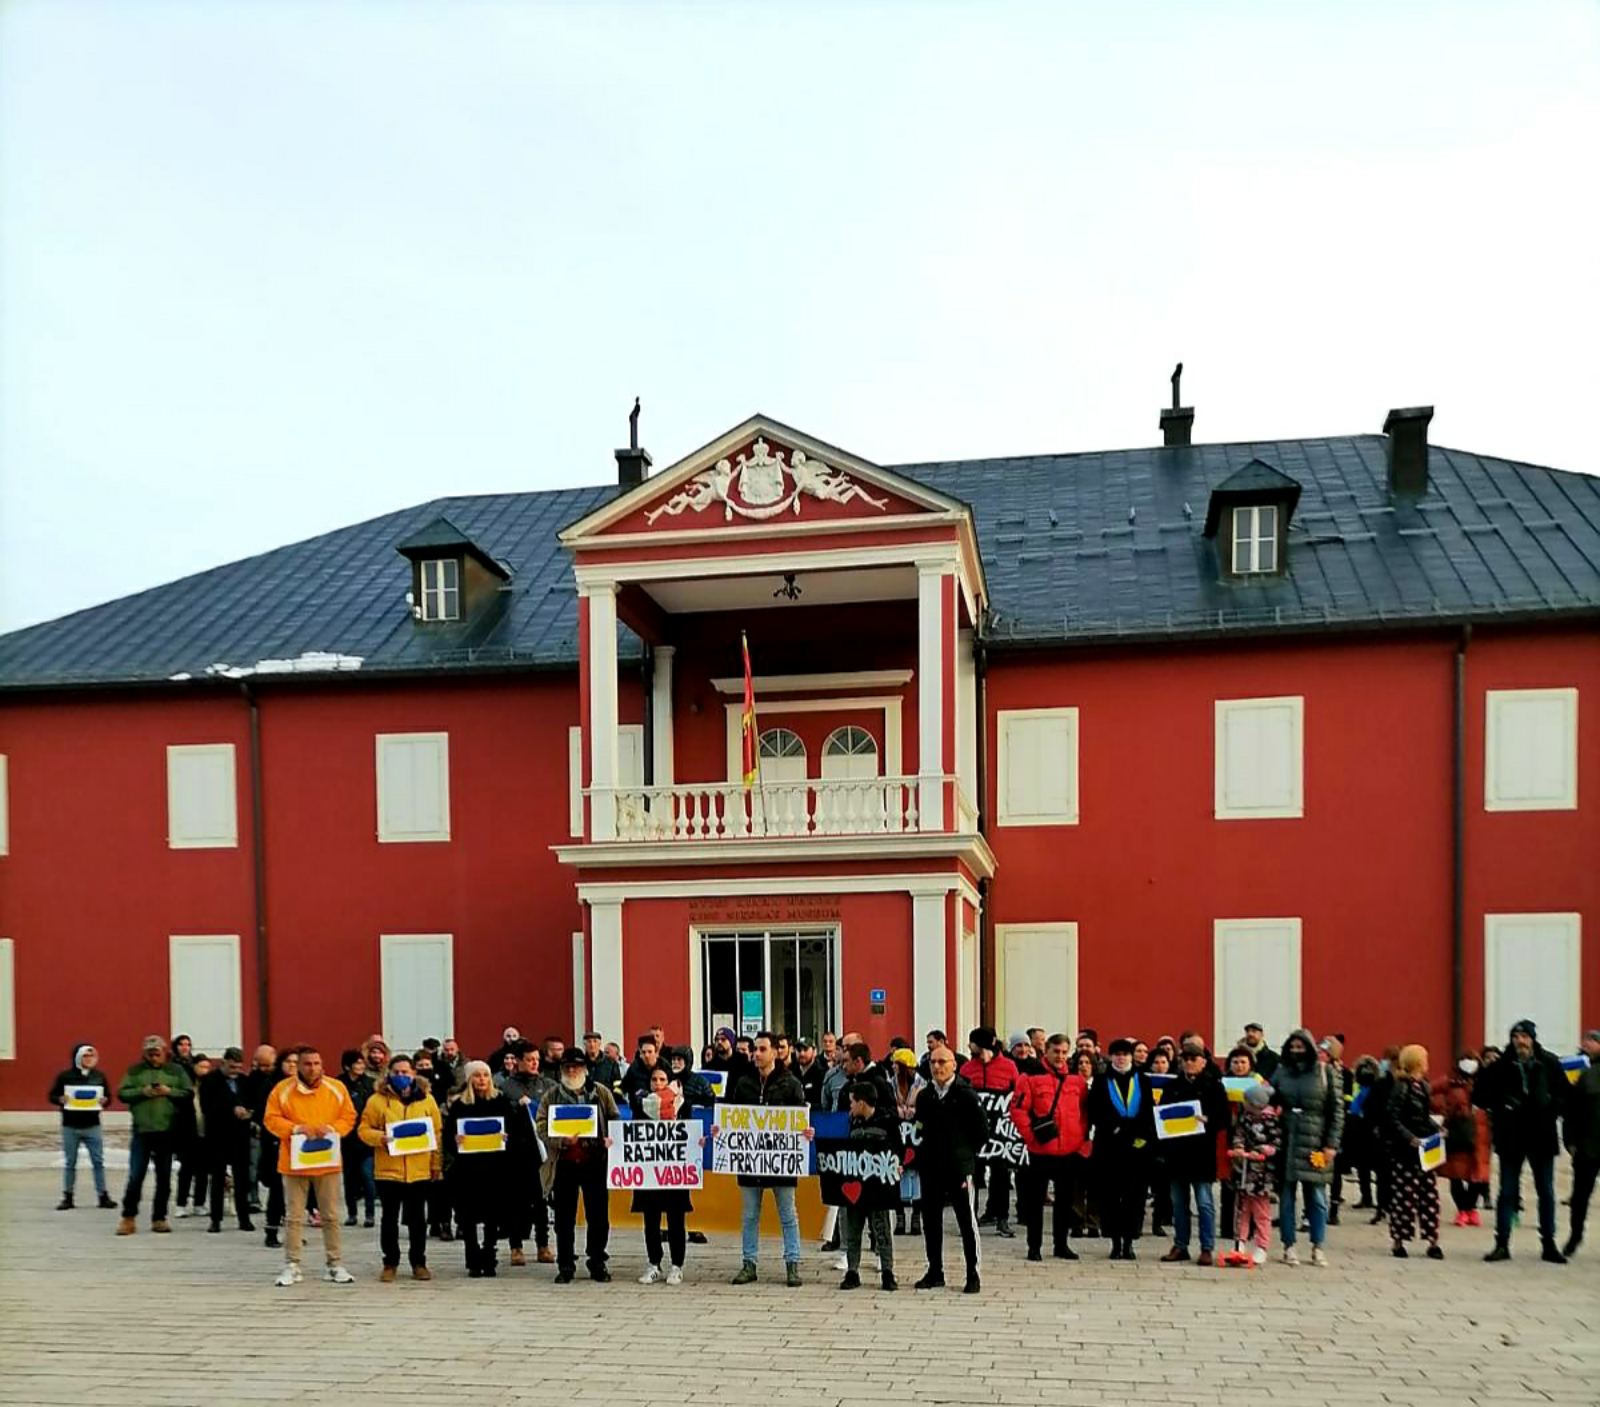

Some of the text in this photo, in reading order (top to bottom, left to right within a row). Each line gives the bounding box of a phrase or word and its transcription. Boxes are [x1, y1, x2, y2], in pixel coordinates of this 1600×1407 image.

[720, 1106, 808, 1132] FOR WHO IS
[623, 1122, 688, 1142] MEDOKS
[611, 1166, 644, 1187] QUO
